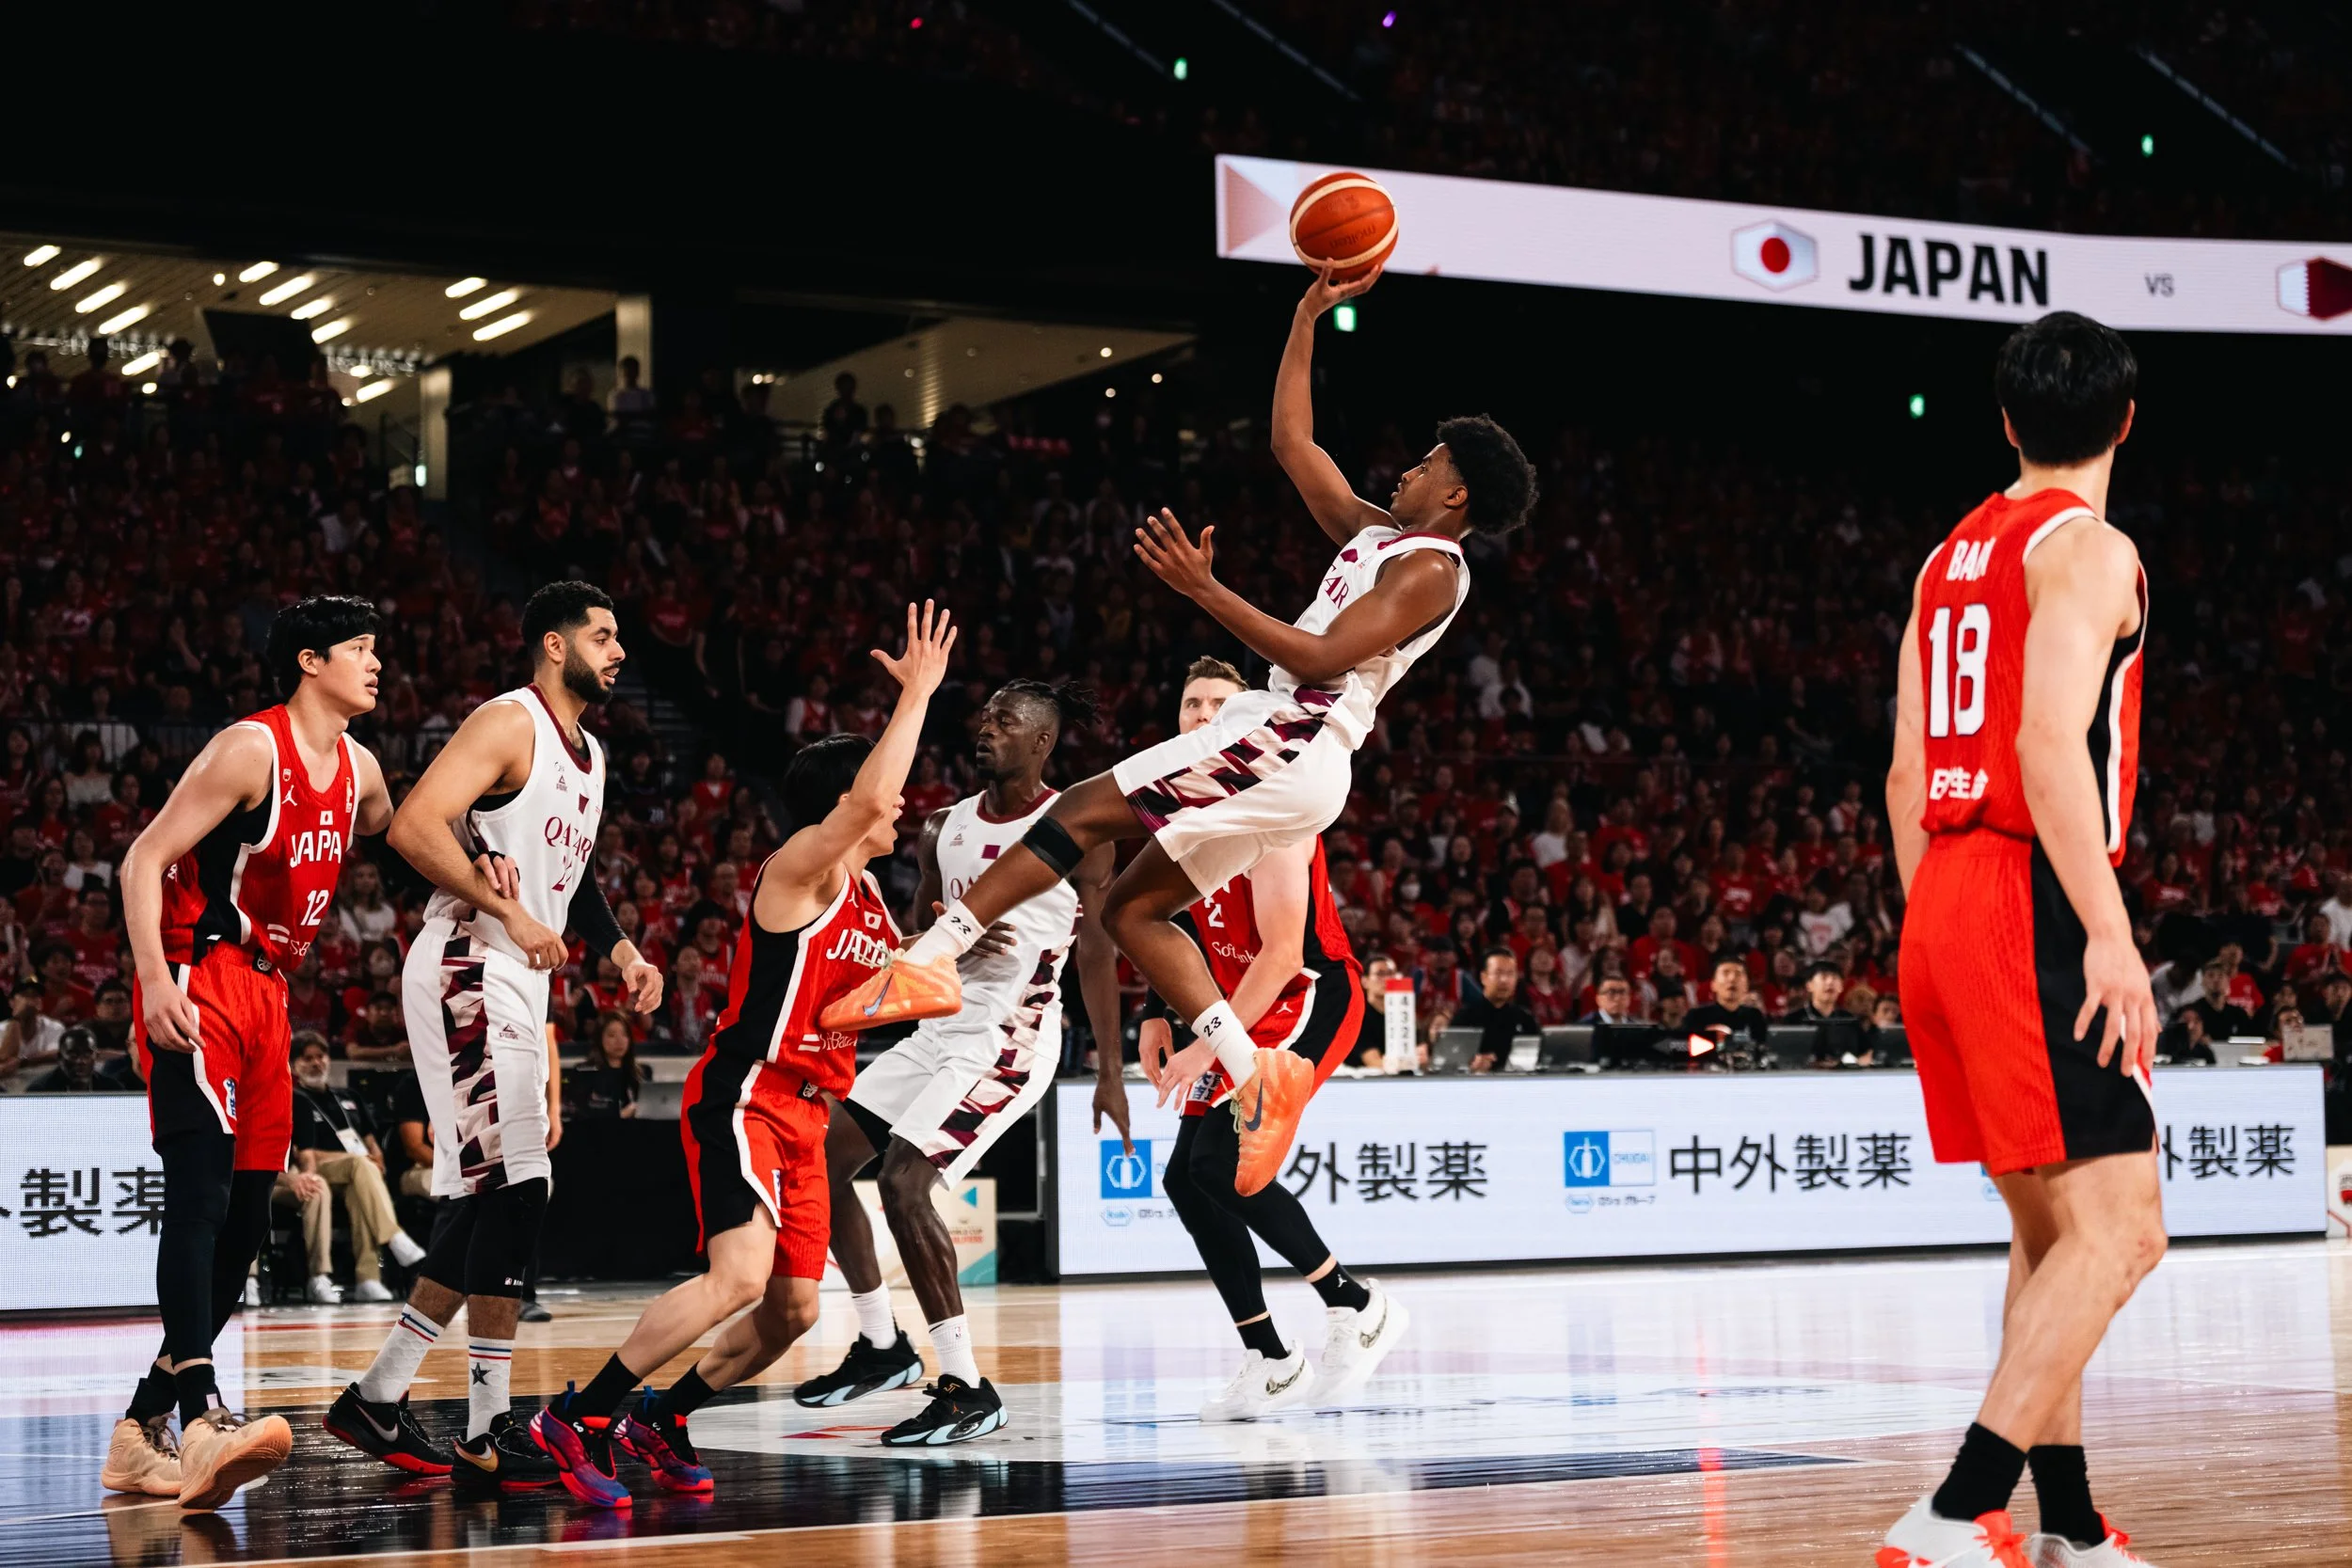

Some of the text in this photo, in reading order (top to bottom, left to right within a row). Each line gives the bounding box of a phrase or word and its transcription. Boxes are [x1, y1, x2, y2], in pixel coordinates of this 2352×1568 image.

[1849, 234, 2174, 307] JAPAN VS
[1930, 603, 1992, 738] 18
[290, 829, 342, 868] JAPA
[300, 890, 329, 927] 12
[1204, 1016, 1222, 1037] 23
[1284, 1141, 1488, 1205] 外製薬
[1669, 1132, 1913, 1195] 中外製薬
[0, 1166, 166, 1238] 製薬
